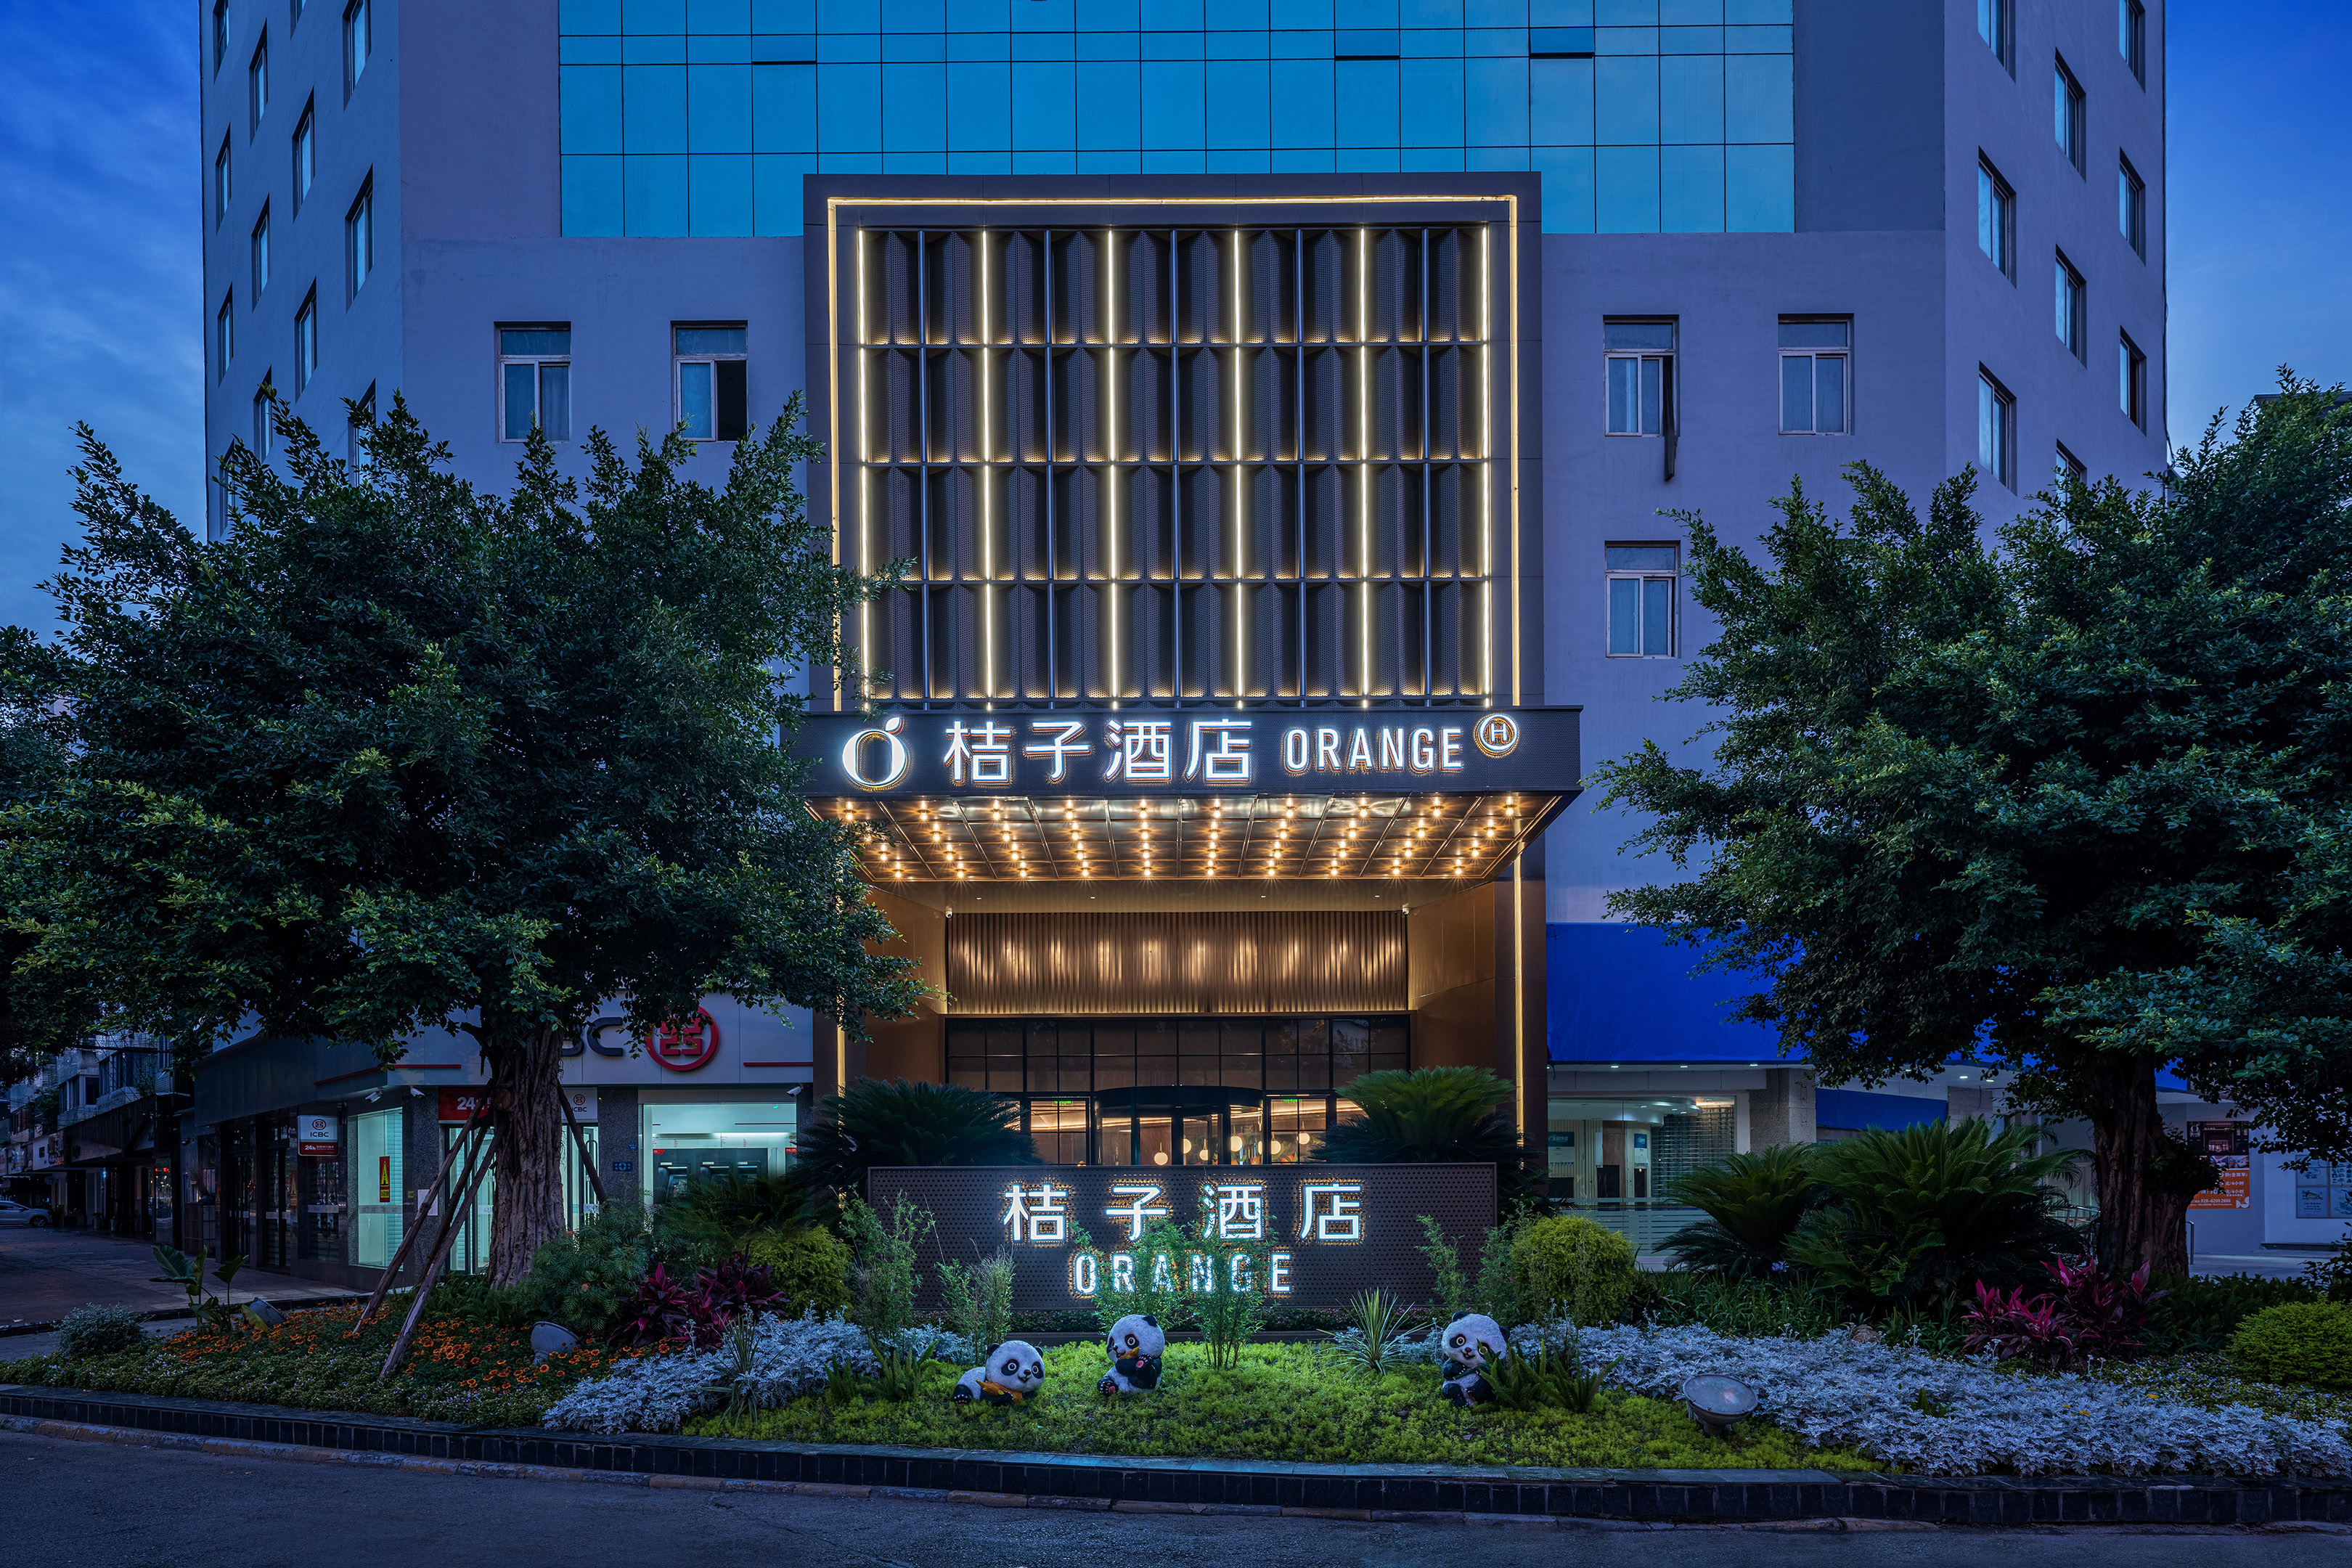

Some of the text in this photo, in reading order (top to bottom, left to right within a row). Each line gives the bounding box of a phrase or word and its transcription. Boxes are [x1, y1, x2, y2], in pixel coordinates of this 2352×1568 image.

[943, 717, 1252, 783] 桔子酒店
[1283, 727, 1463, 772] ORANGE
[1003, 1183, 1361, 1241] 桔子酒店
[1074, 1254, 1291, 1294] ORANGE
